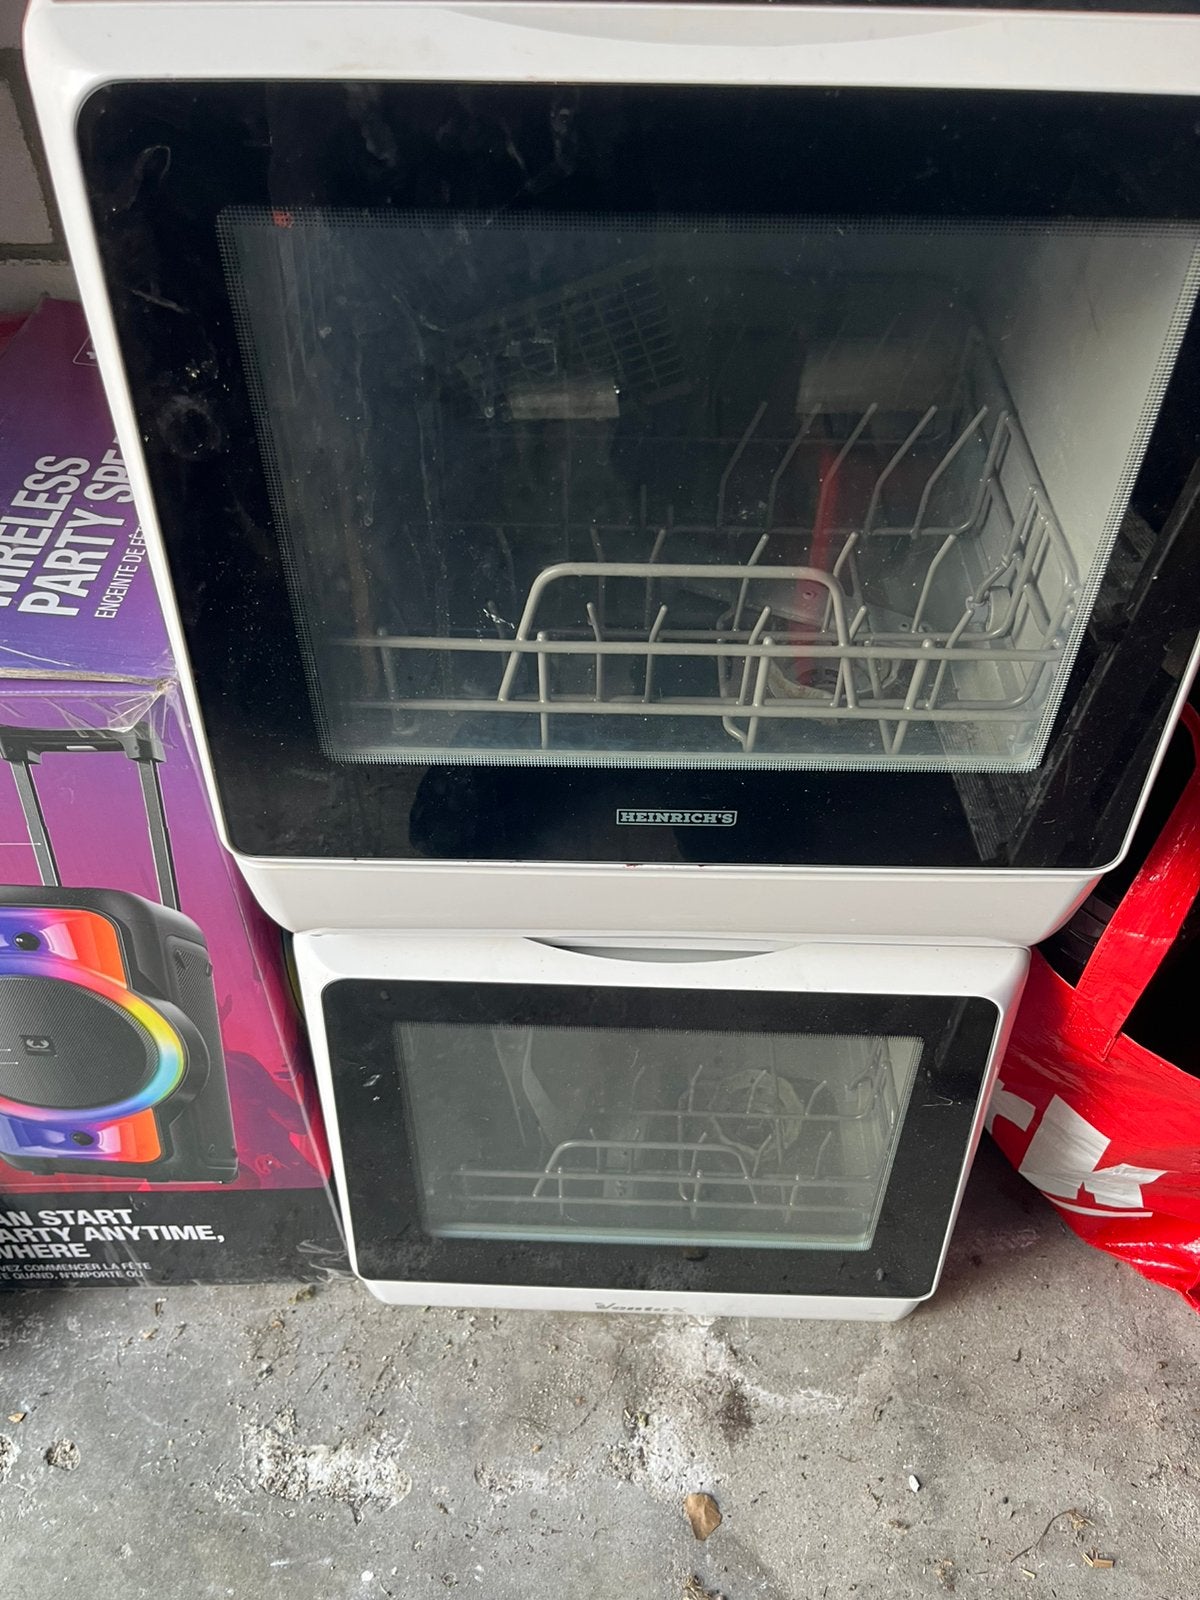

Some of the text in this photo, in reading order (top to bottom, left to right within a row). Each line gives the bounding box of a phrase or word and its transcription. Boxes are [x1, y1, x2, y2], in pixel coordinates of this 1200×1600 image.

[17, 508, 125, 616] PARTY
[94, 559, 138, 618] ENCEINTE
[123, 546, 146, 562] DE
[620, 812, 733, 824] HEINRICH'S
[38, 1209, 132, 1226] START
[85, 1225, 225, 1243] ANYTIME,
[22, 1263, 101, 1271] COMMENCER
[102, 1262, 120, 1270] LA
